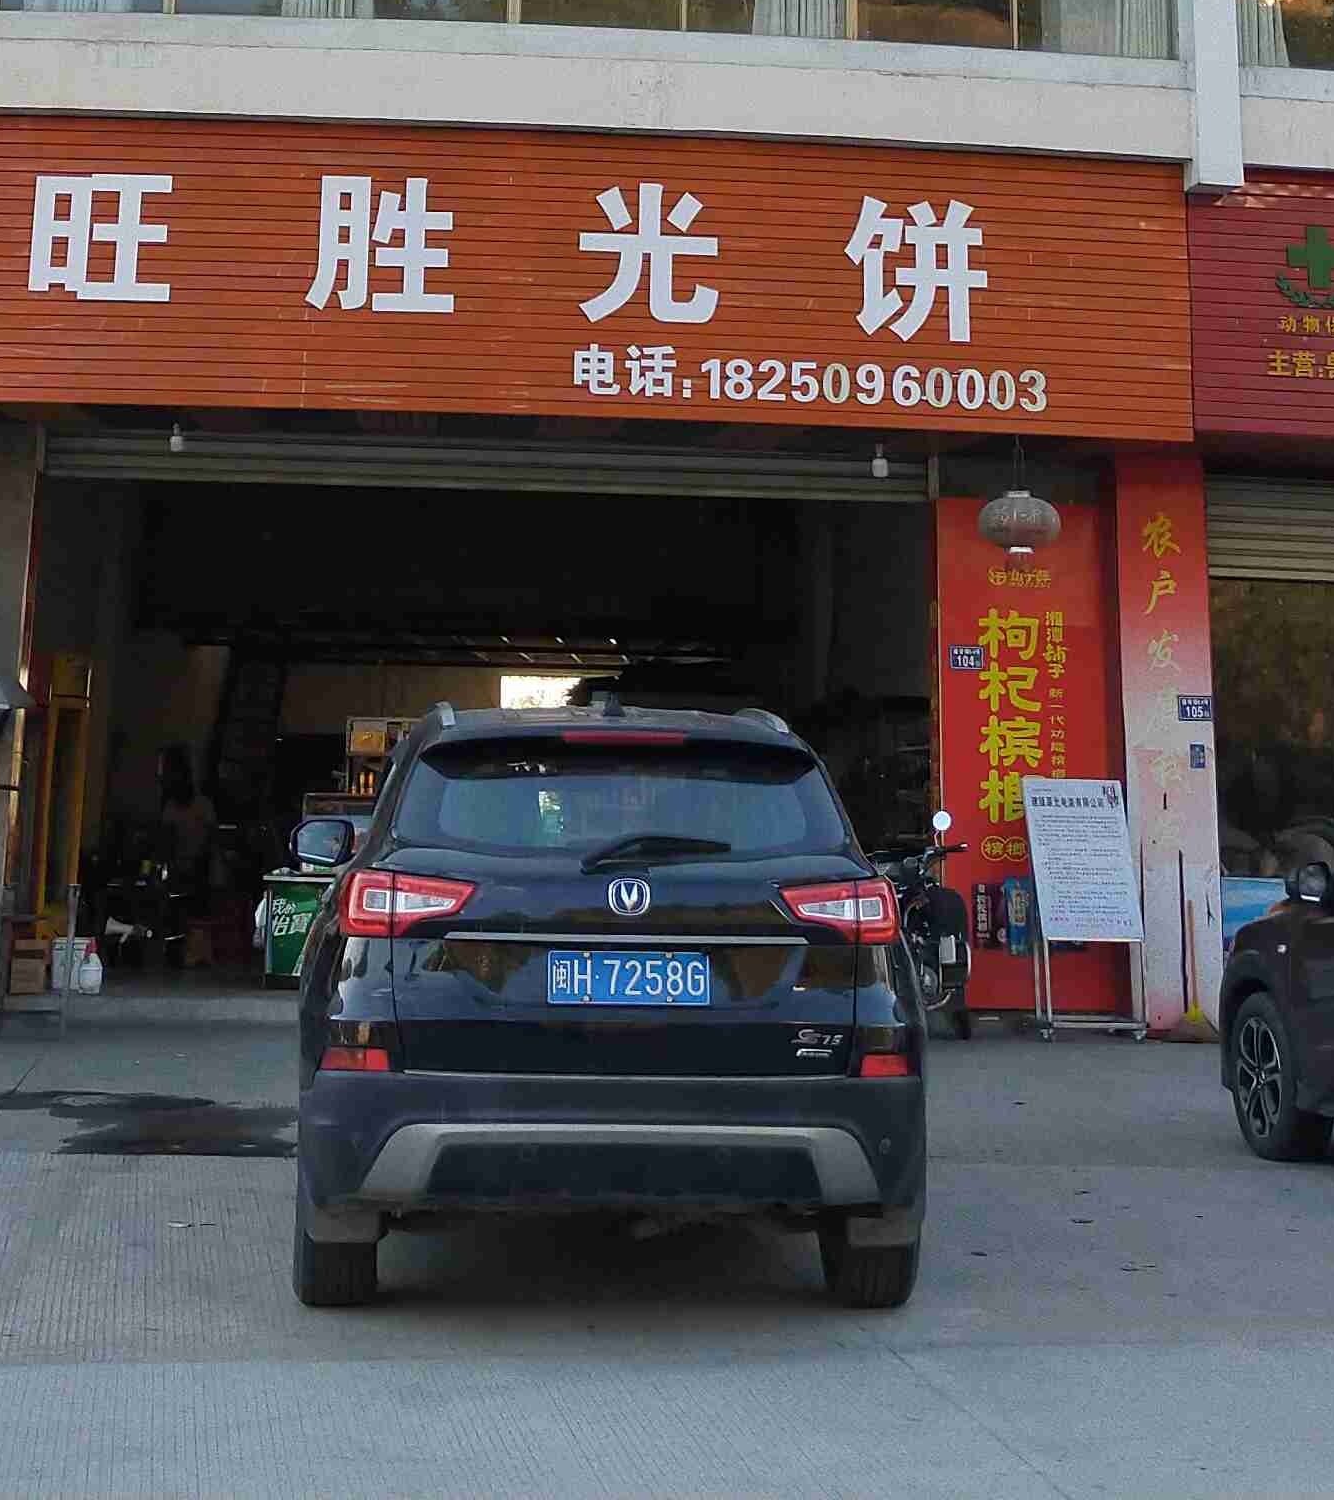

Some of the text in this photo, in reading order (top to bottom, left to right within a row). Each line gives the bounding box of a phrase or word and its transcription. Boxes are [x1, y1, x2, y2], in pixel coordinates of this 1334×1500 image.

[27, 172, 990, 344] 旺胜光饼
[571, 342, 1049, 414] 电话:18250960003
